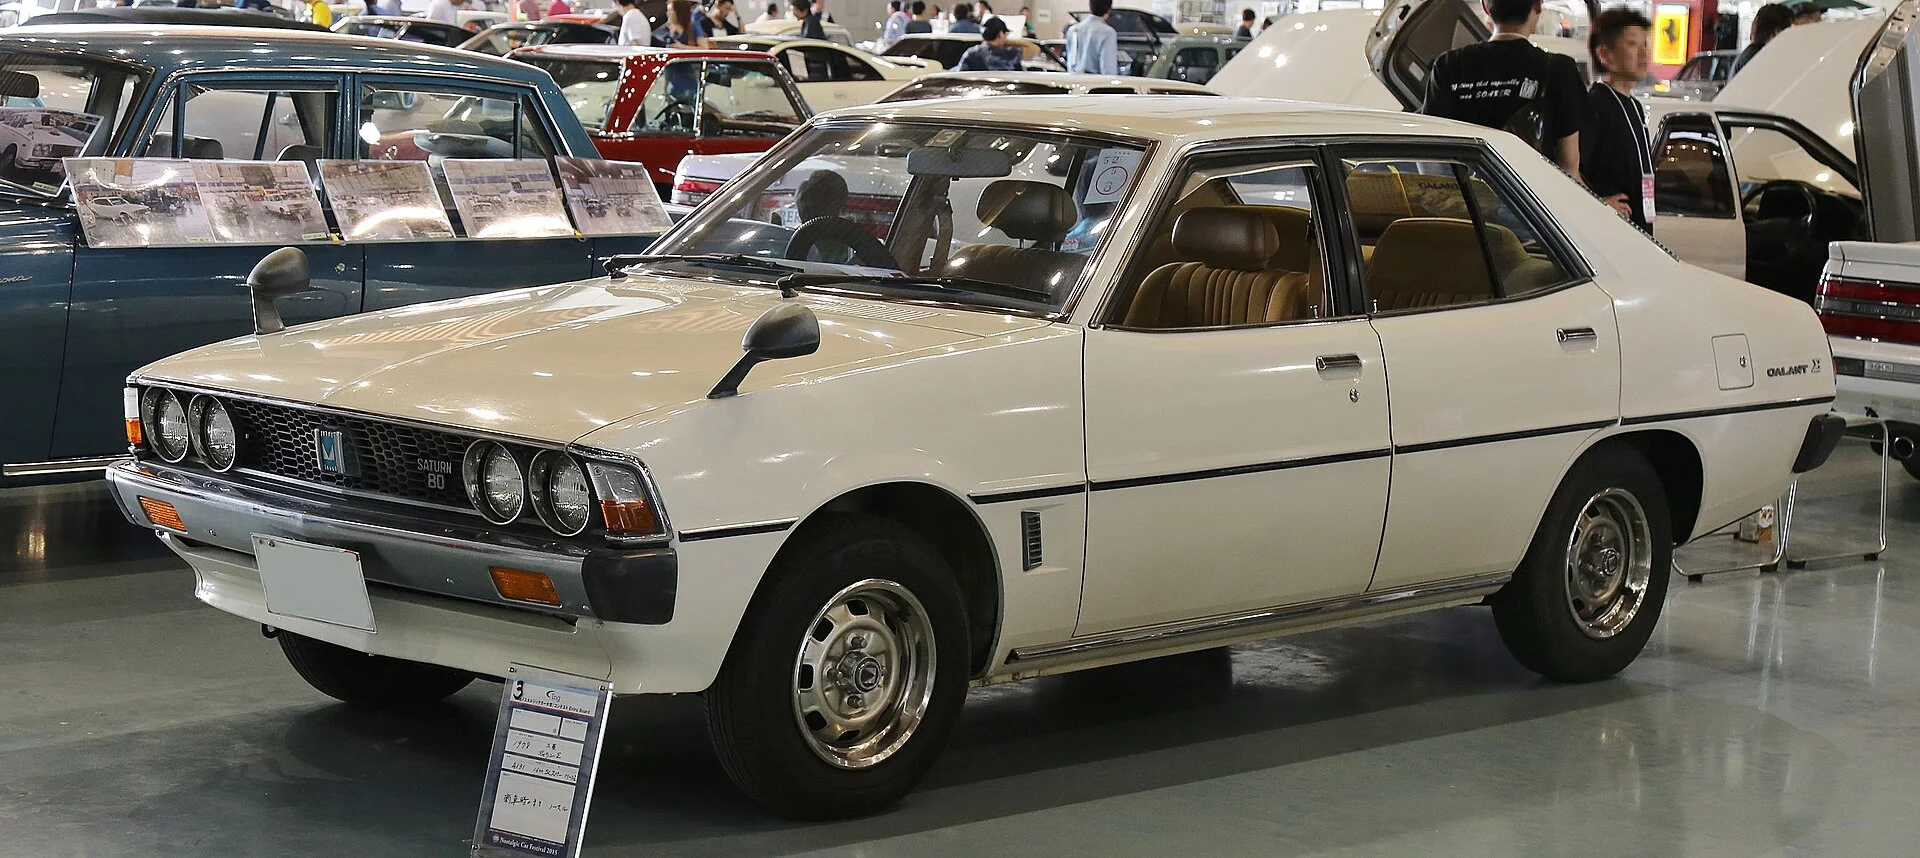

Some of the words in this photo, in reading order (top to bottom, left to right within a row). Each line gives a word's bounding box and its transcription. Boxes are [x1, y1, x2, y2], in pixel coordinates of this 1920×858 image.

[417, 458, 452, 474] SATURN
[428, 473, 445, 490] 80
[513, 680, 524, 700] 3
[500, 836, 520, 848] Nostalgic
[520, 841, 529, 849] Car
[529, 844, 546, 853] Festival
[546, 847, 558, 856] 2015
